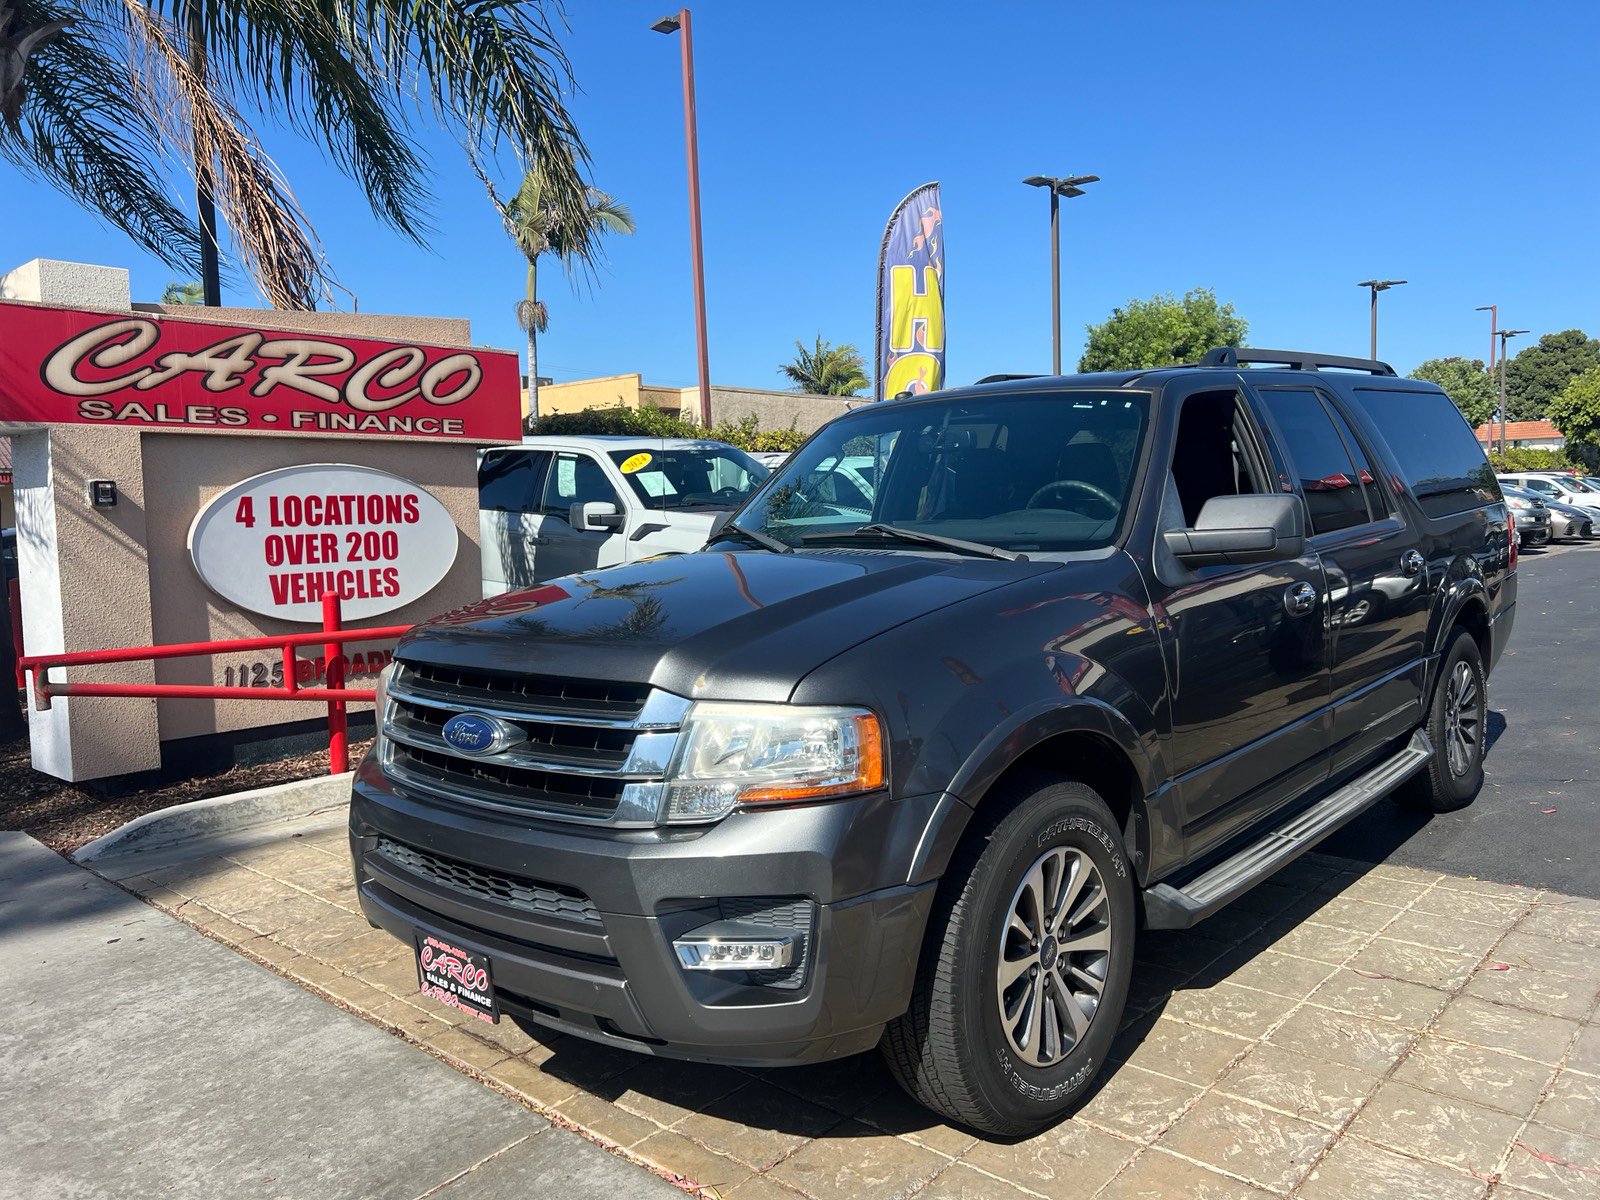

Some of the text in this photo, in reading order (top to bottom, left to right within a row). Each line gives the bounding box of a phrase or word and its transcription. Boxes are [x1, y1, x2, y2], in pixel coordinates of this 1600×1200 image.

[40, 319, 483, 412] CARCO
[78, 399, 465, 435] SALES FINANCE
[235, 494, 420, 528] 4 LOCATIONS
[264, 530, 399, 567] OVER 200
[269, 567, 400, 606] VEHICLES
[224, 660, 284, 688] 1125
[450, 720, 483, 745] Ford
[421, 946, 489, 991] CARCO
[426, 972, 492, 1007] SALES & FINANCE
